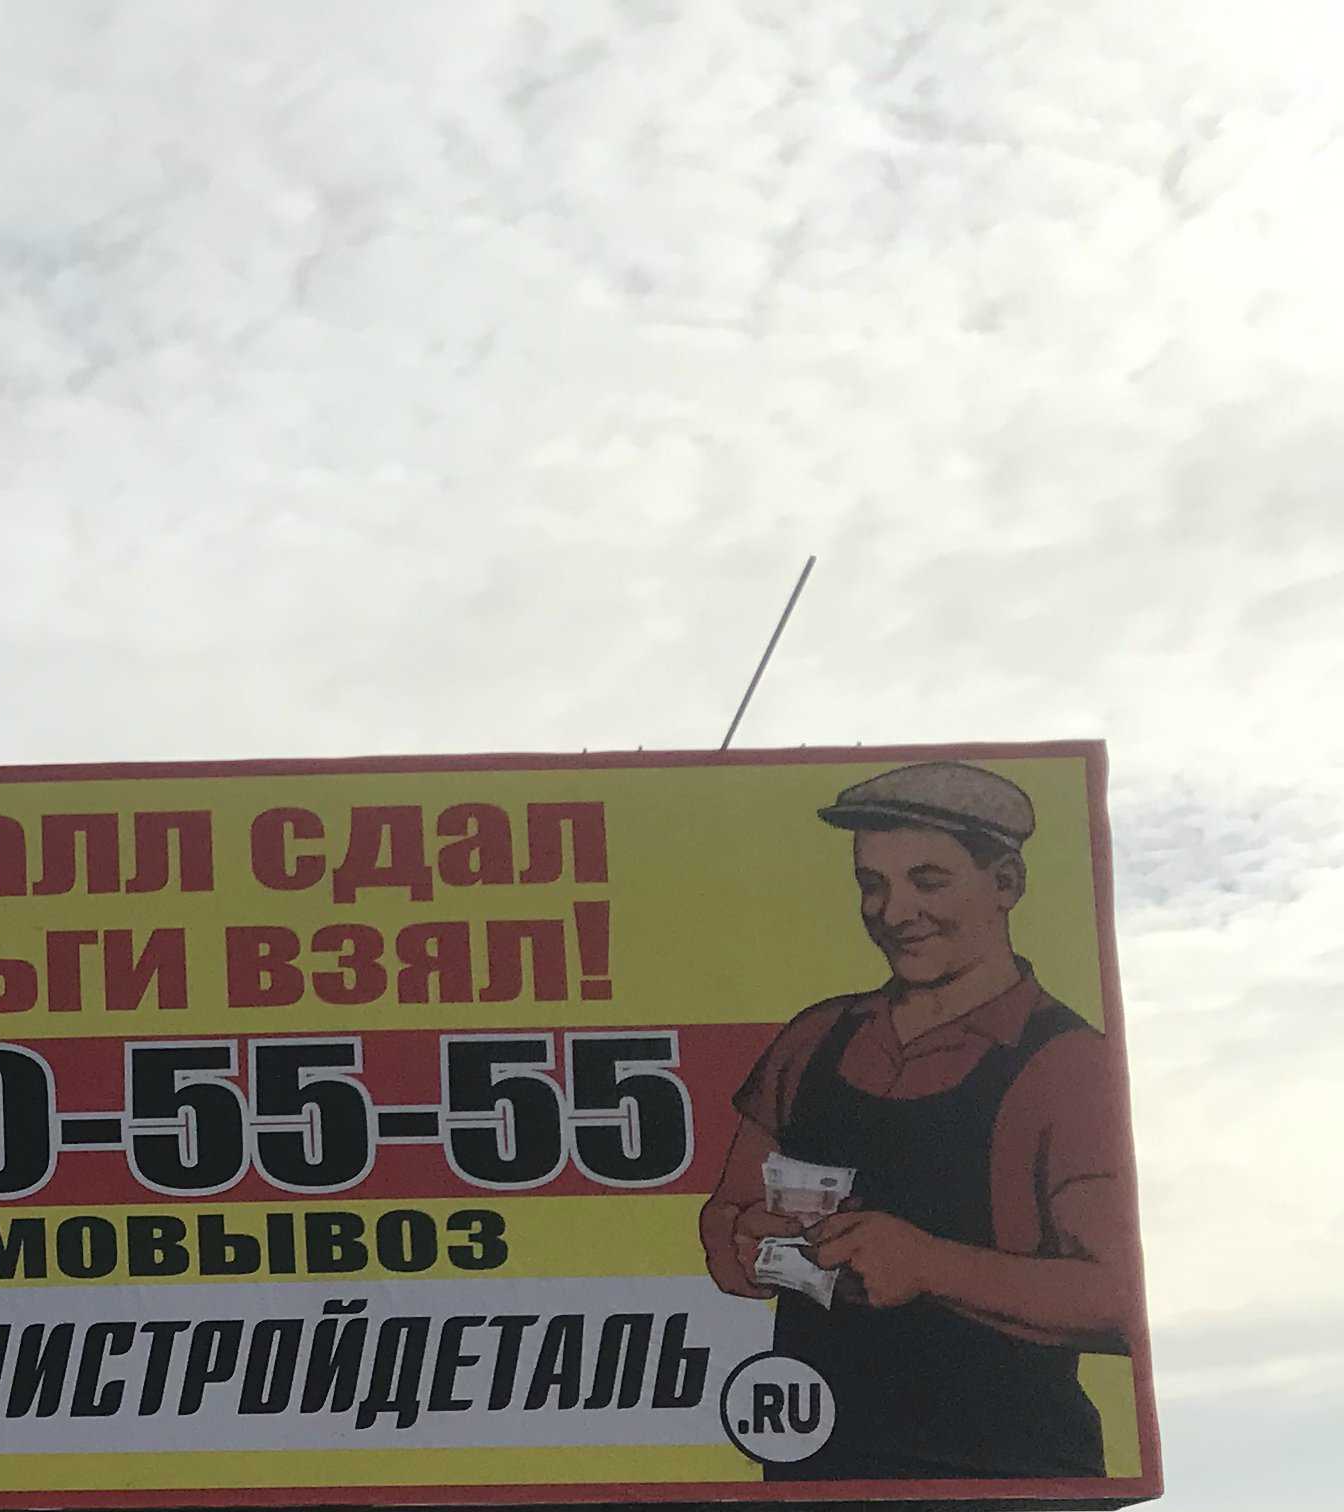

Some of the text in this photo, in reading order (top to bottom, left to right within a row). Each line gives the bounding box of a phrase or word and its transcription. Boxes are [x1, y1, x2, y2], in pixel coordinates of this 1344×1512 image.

[249, 800, 609, 903] сдал
[225, 899, 613, 1007] взял!
[736, 1380, 821, 1434] .RU
